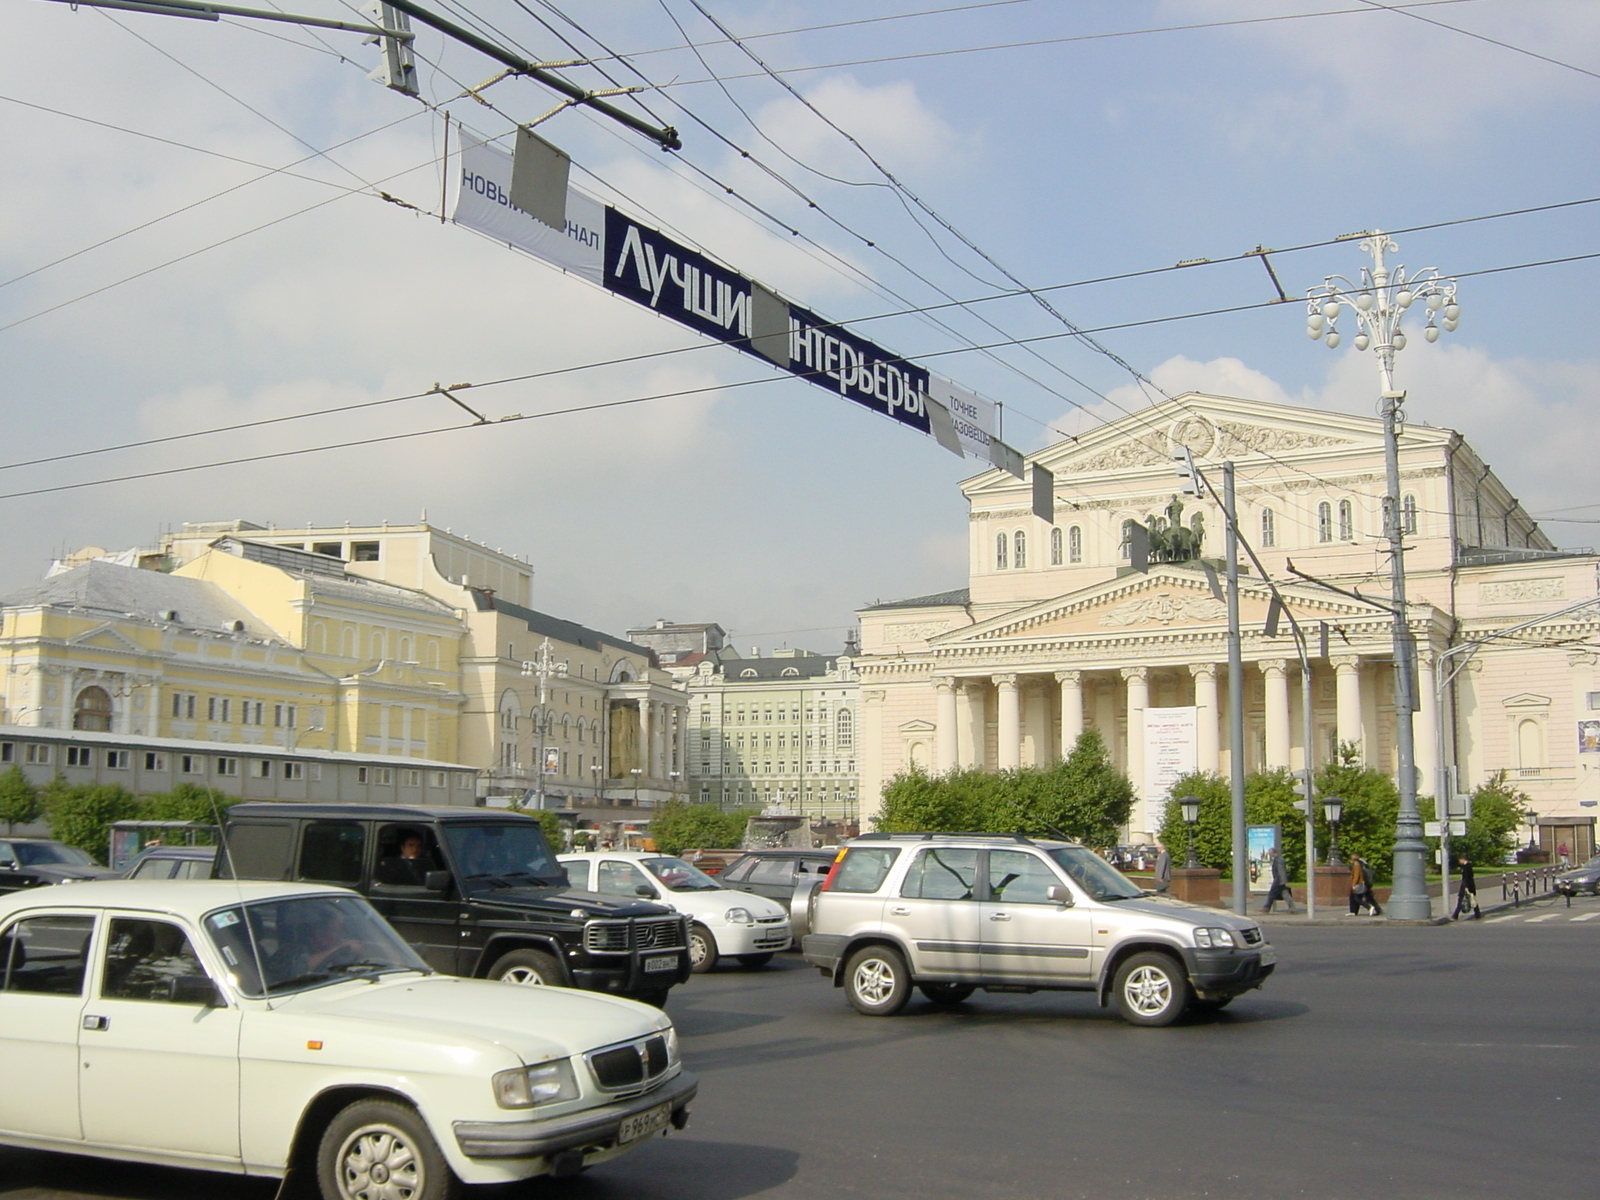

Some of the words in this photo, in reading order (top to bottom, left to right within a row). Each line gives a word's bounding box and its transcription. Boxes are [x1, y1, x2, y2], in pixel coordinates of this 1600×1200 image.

[462, 168, 524, 214] НОВЫ
[949, 395, 978, 420] ТОЧНЕЕ
[951, 417, 990, 447] АЗОВЕШЬ
